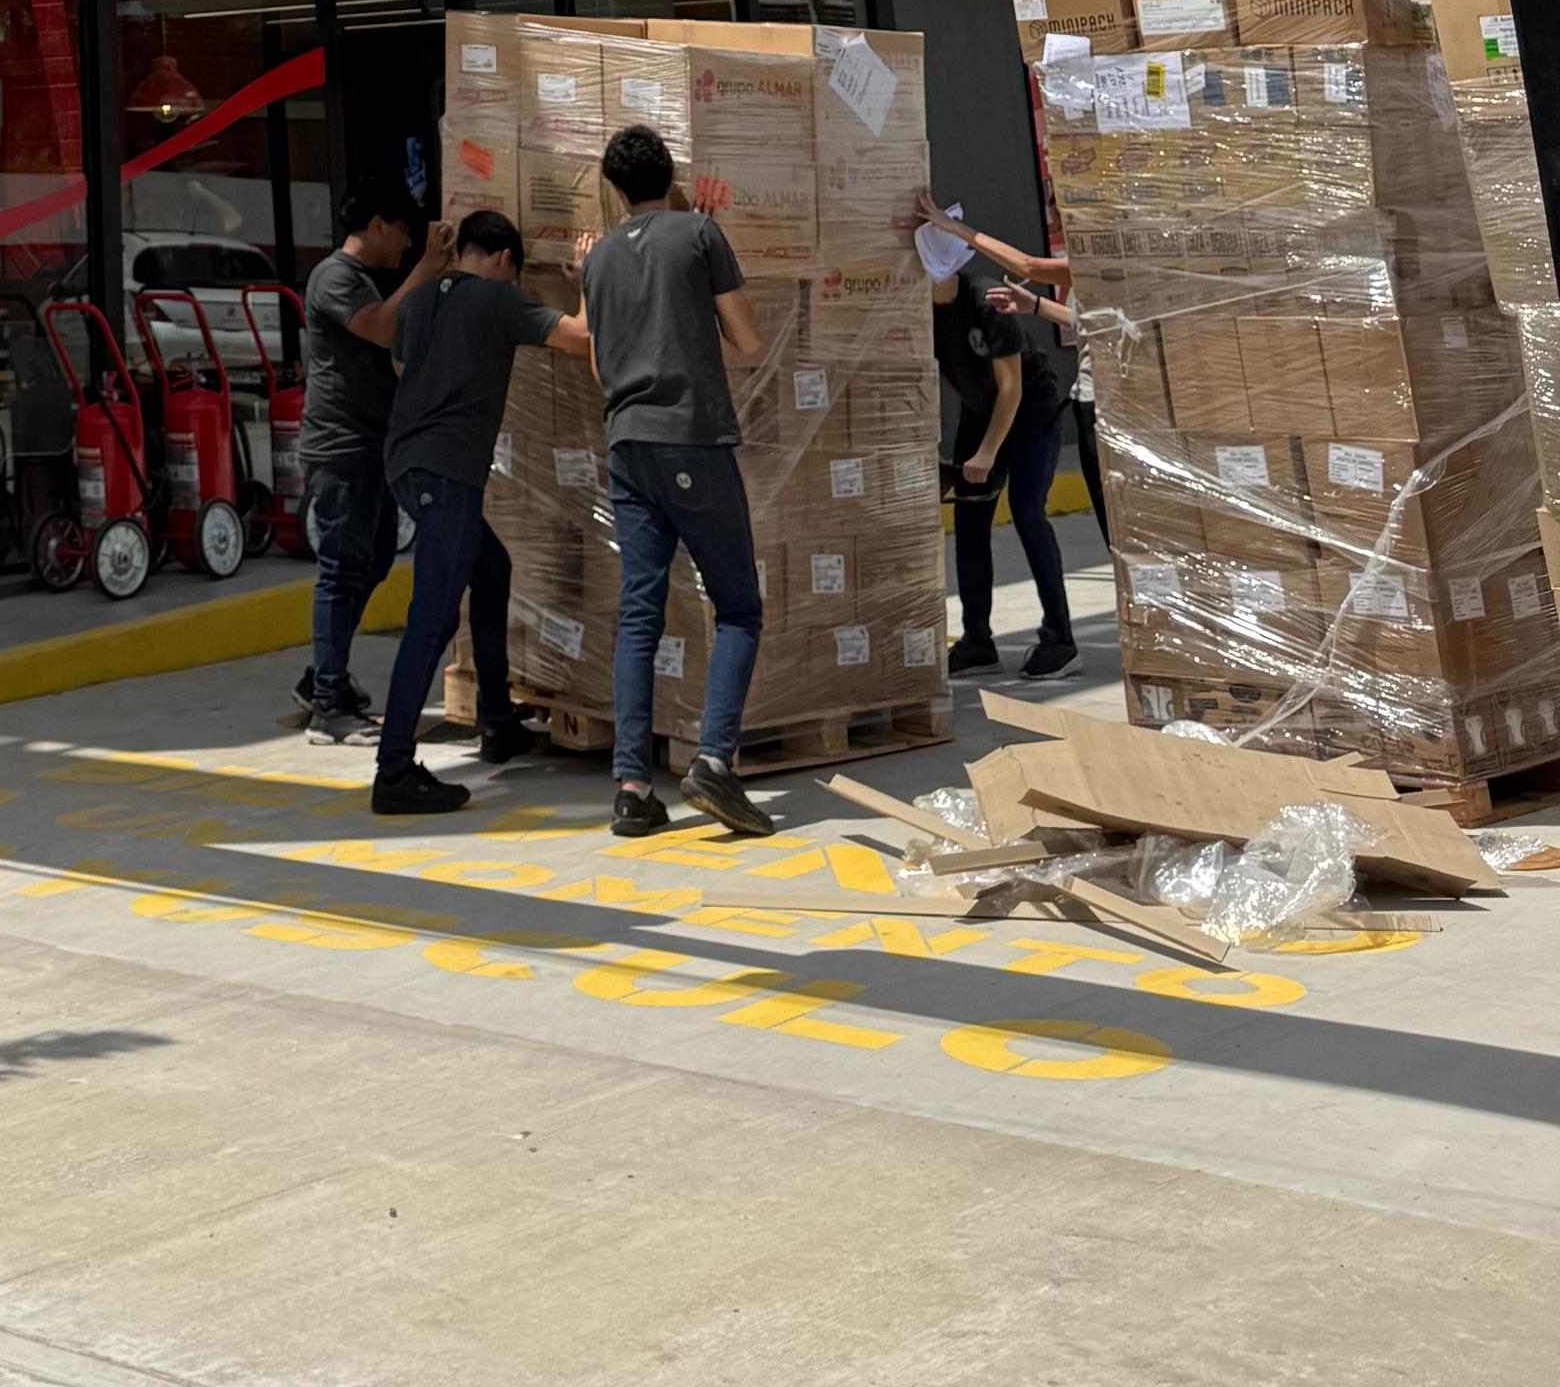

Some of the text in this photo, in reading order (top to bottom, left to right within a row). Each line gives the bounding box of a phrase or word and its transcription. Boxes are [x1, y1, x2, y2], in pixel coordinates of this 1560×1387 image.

[716, 79, 802, 97] grupo ALMAR
[844, 276, 881, 295] grupo
[278, 837, 1306, 1009] MOMENTO
